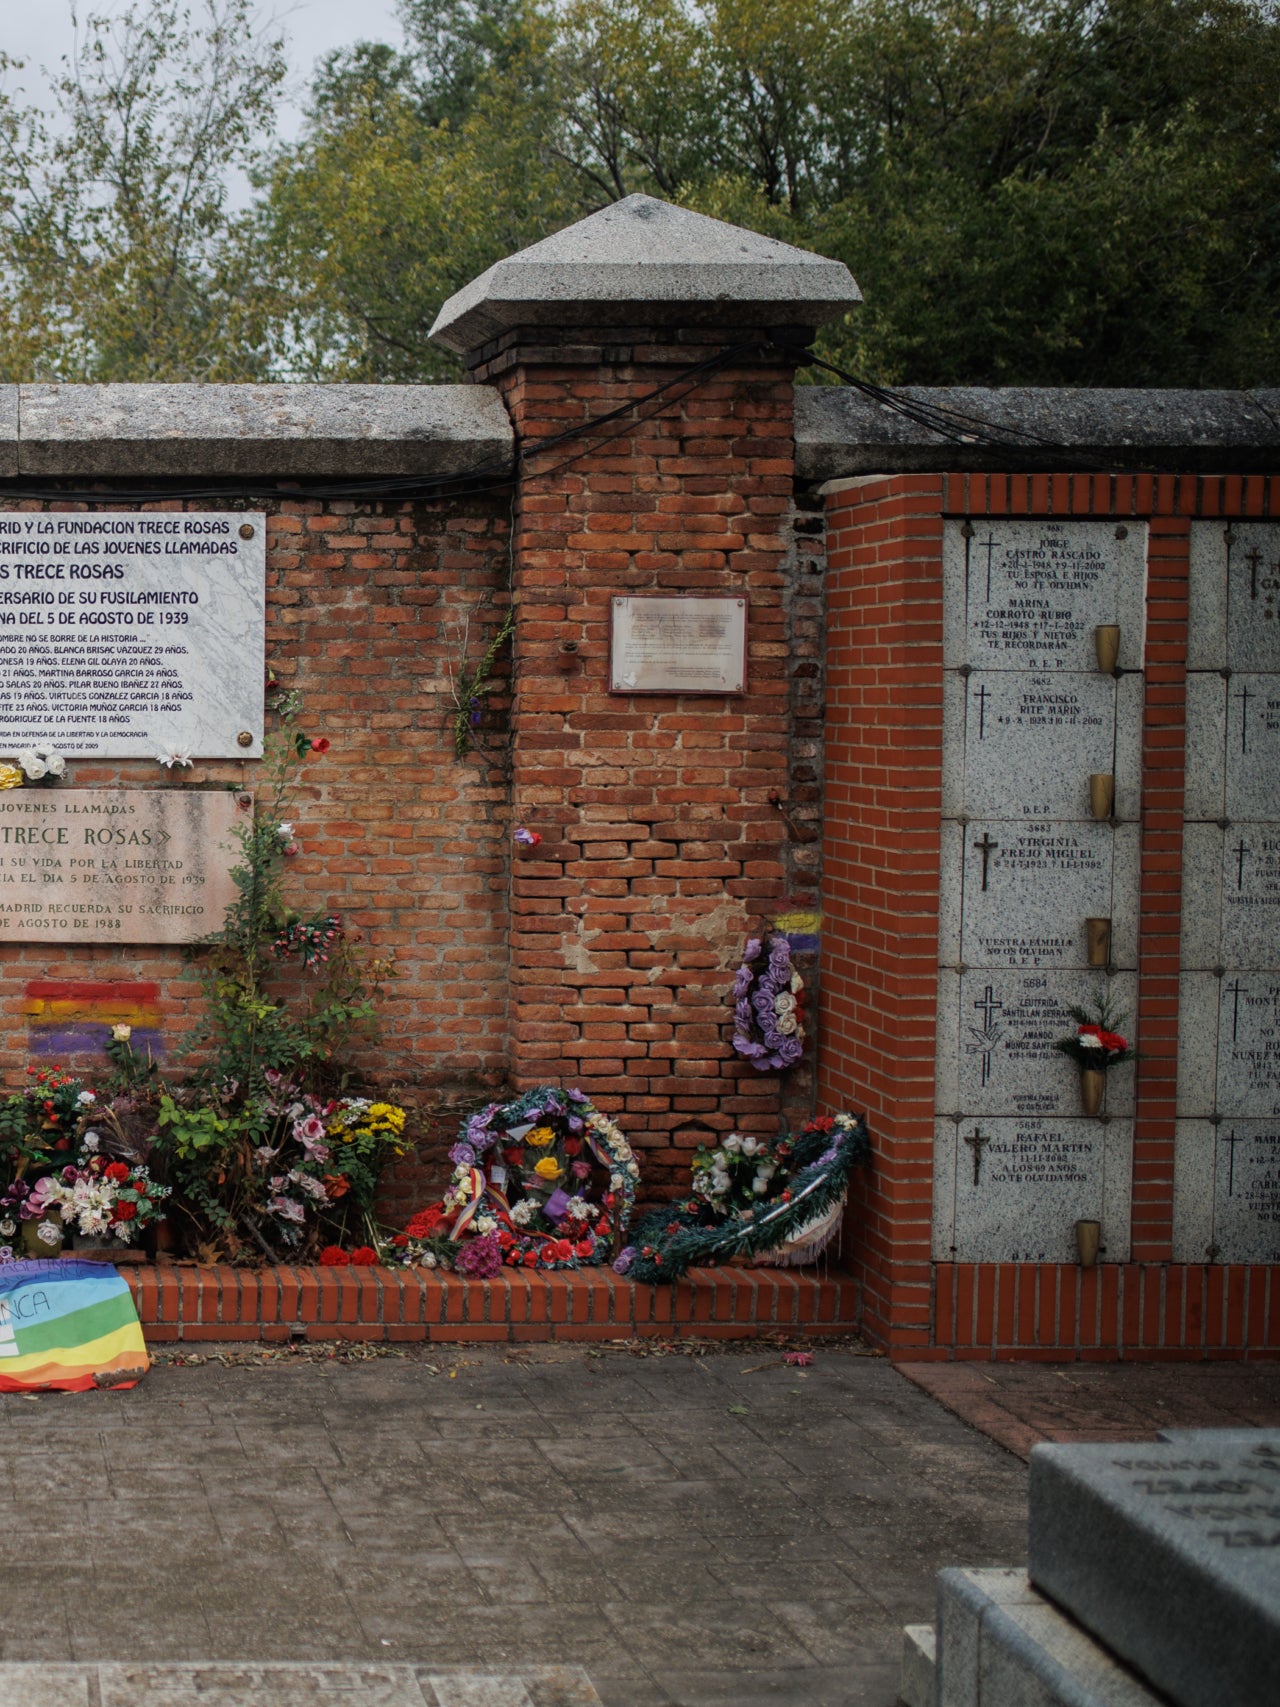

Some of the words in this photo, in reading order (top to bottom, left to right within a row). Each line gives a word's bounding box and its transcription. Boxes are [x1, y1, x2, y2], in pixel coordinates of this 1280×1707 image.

[25, 522, 34, 534] Y
[37, 521, 54, 534] LA
[57, 521, 134, 534] FUNDACION
[137, 521, 180, 534] TRECE
[184, 521, 230, 534] ROSAS
[53, 542, 70, 554] DE
[74, 541, 99, 554] LAS
[103, 541, 161, 554] JOVENES
[165, 541, 238, 554] LLAMADAS
[1040, 539, 1070, 549] JORGE
[1006, 550, 1046, 559] CASTRO
[1051, 551, 1101, 560] RASCADO
[14, 564, 65, 579] TRECE
[58, 592, 75, 604] DE
[79, 592, 97, 604] SU
[100, 591, 199, 604] FUSILAMIENTO
[1008, 599, 1050, 608] MARINA
[19, 612, 44, 624] DEL
[48, 612, 55, 624] 5
[59, 612, 75, 624] DE
[79, 612, 134, 624] AGOSTO
[137, 612, 154, 624] DE
[160, 612, 189, 624] 1939
[986, 610, 1035, 620] CORROTO
[1040, 611, 1072, 620] RUBIO
[18, 646, 27, 654] 20
[54, 646, 85, 654] BLANCA
[86, 646, 115, 654] BRISAC
[116, 646, 153, 654] VAZQUEZ
[154, 646, 163, 654] 29
[101, 658, 127, 666] OLAYA
[1023, 694, 1078, 704] FRANCISCO
[65, 805, 136, 814] LLAMADAS
[1, 826, 69, 844] TRECE
[1018, 837, 1078, 847] VIRGINIA
[1001, 849, 1041, 858] FREJO
[1045, 849, 1095, 859] MIGUEL
[11, 858, 26, 866] SU
[32, 858, 62, 867] VIDA
[70, 858, 95, 869] POR
[102, 860, 118, 870] LA
[125, 859, 184, 870] LIBERTAD
[48, 904, 112, 914] RECUERDA
[118, 905, 133, 914] SU
[139, 905, 204, 915] SACRIFICIO
[1023, 979, 1047, 988] 5684
[1016, 1133, 1064, 1142] RAFAEL
[988, 1144, 1037, 1153] VALERO
[1041, 1144, 1093, 1153] MARTIN
